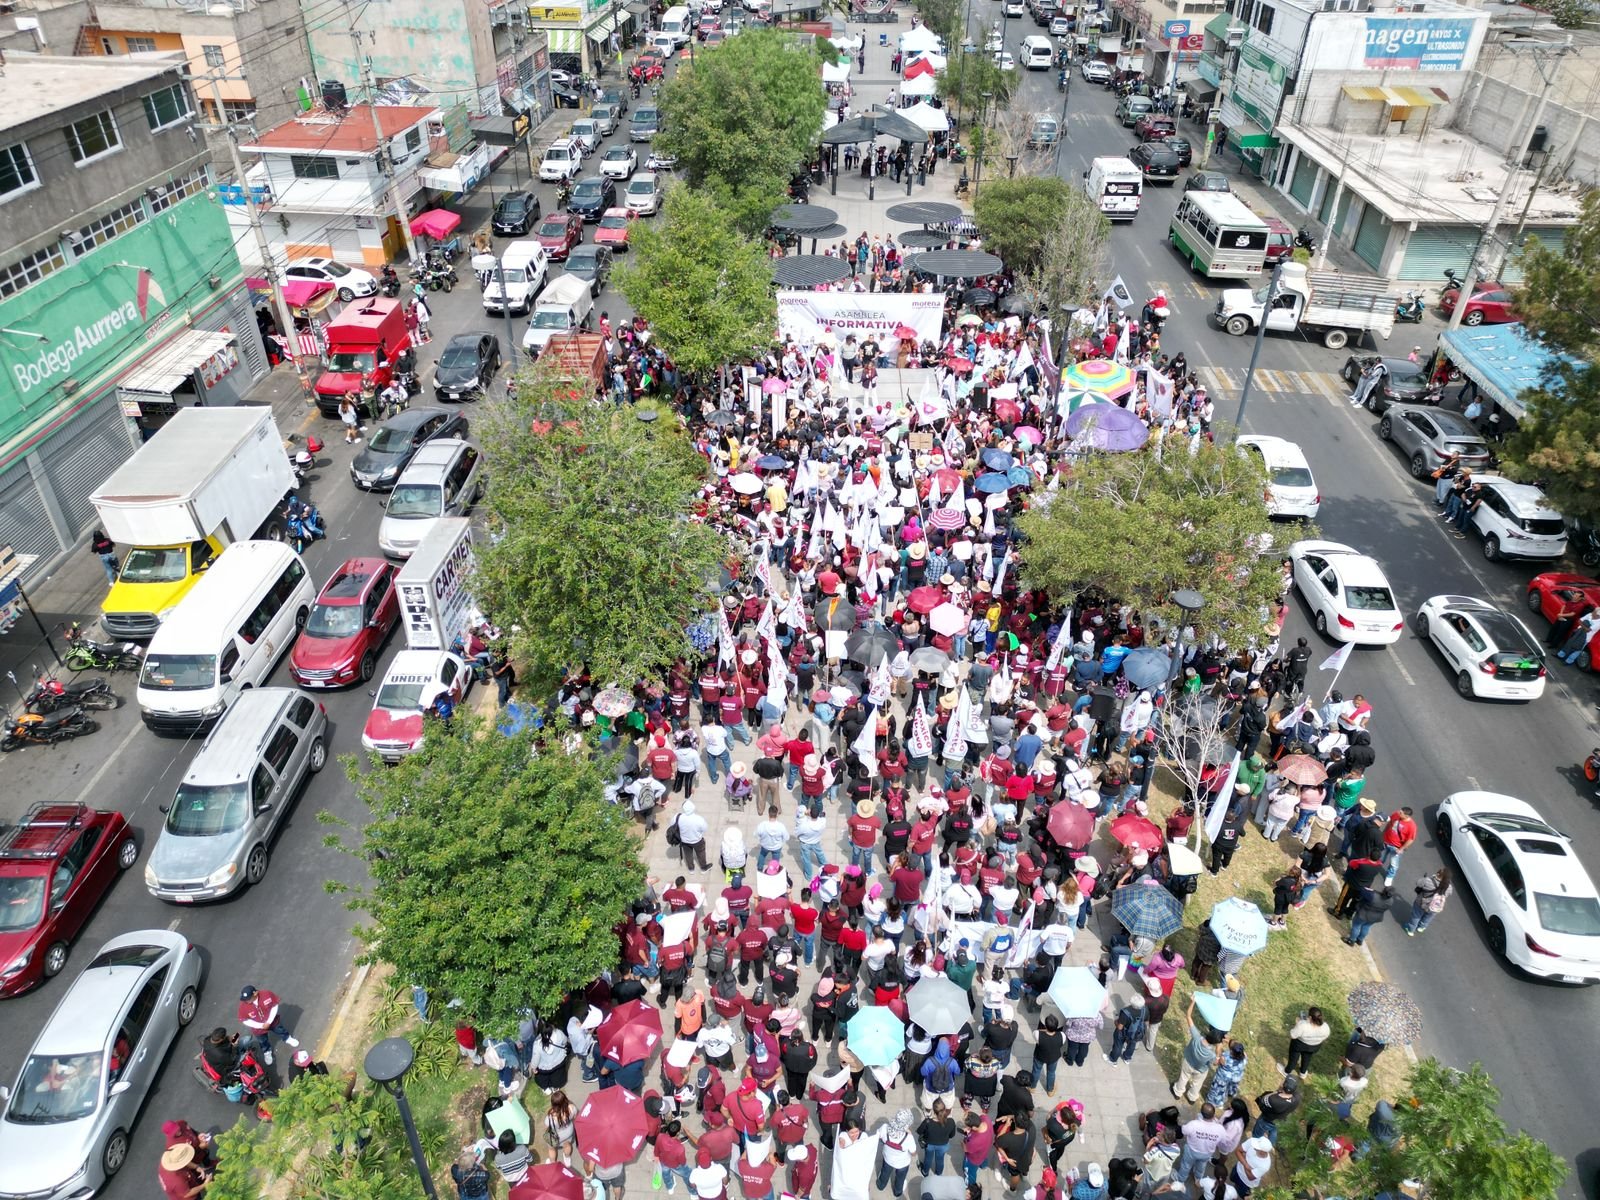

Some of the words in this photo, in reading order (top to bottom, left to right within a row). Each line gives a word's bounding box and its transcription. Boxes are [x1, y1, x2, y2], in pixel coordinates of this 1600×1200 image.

[1453, 29, 1462, 38] X
[1427, 41, 1466, 50] ULTRASONIDO
[834, 311, 886, 319] ASAMBLEA
[816, 317, 904, 330] INFORMATIVA
[13, 339, 80, 393] Bodega
[74, 300, 138, 356] Aurrera
[435, 530, 473, 600] CARMEN
[391, 675, 432, 683] UNDEN
